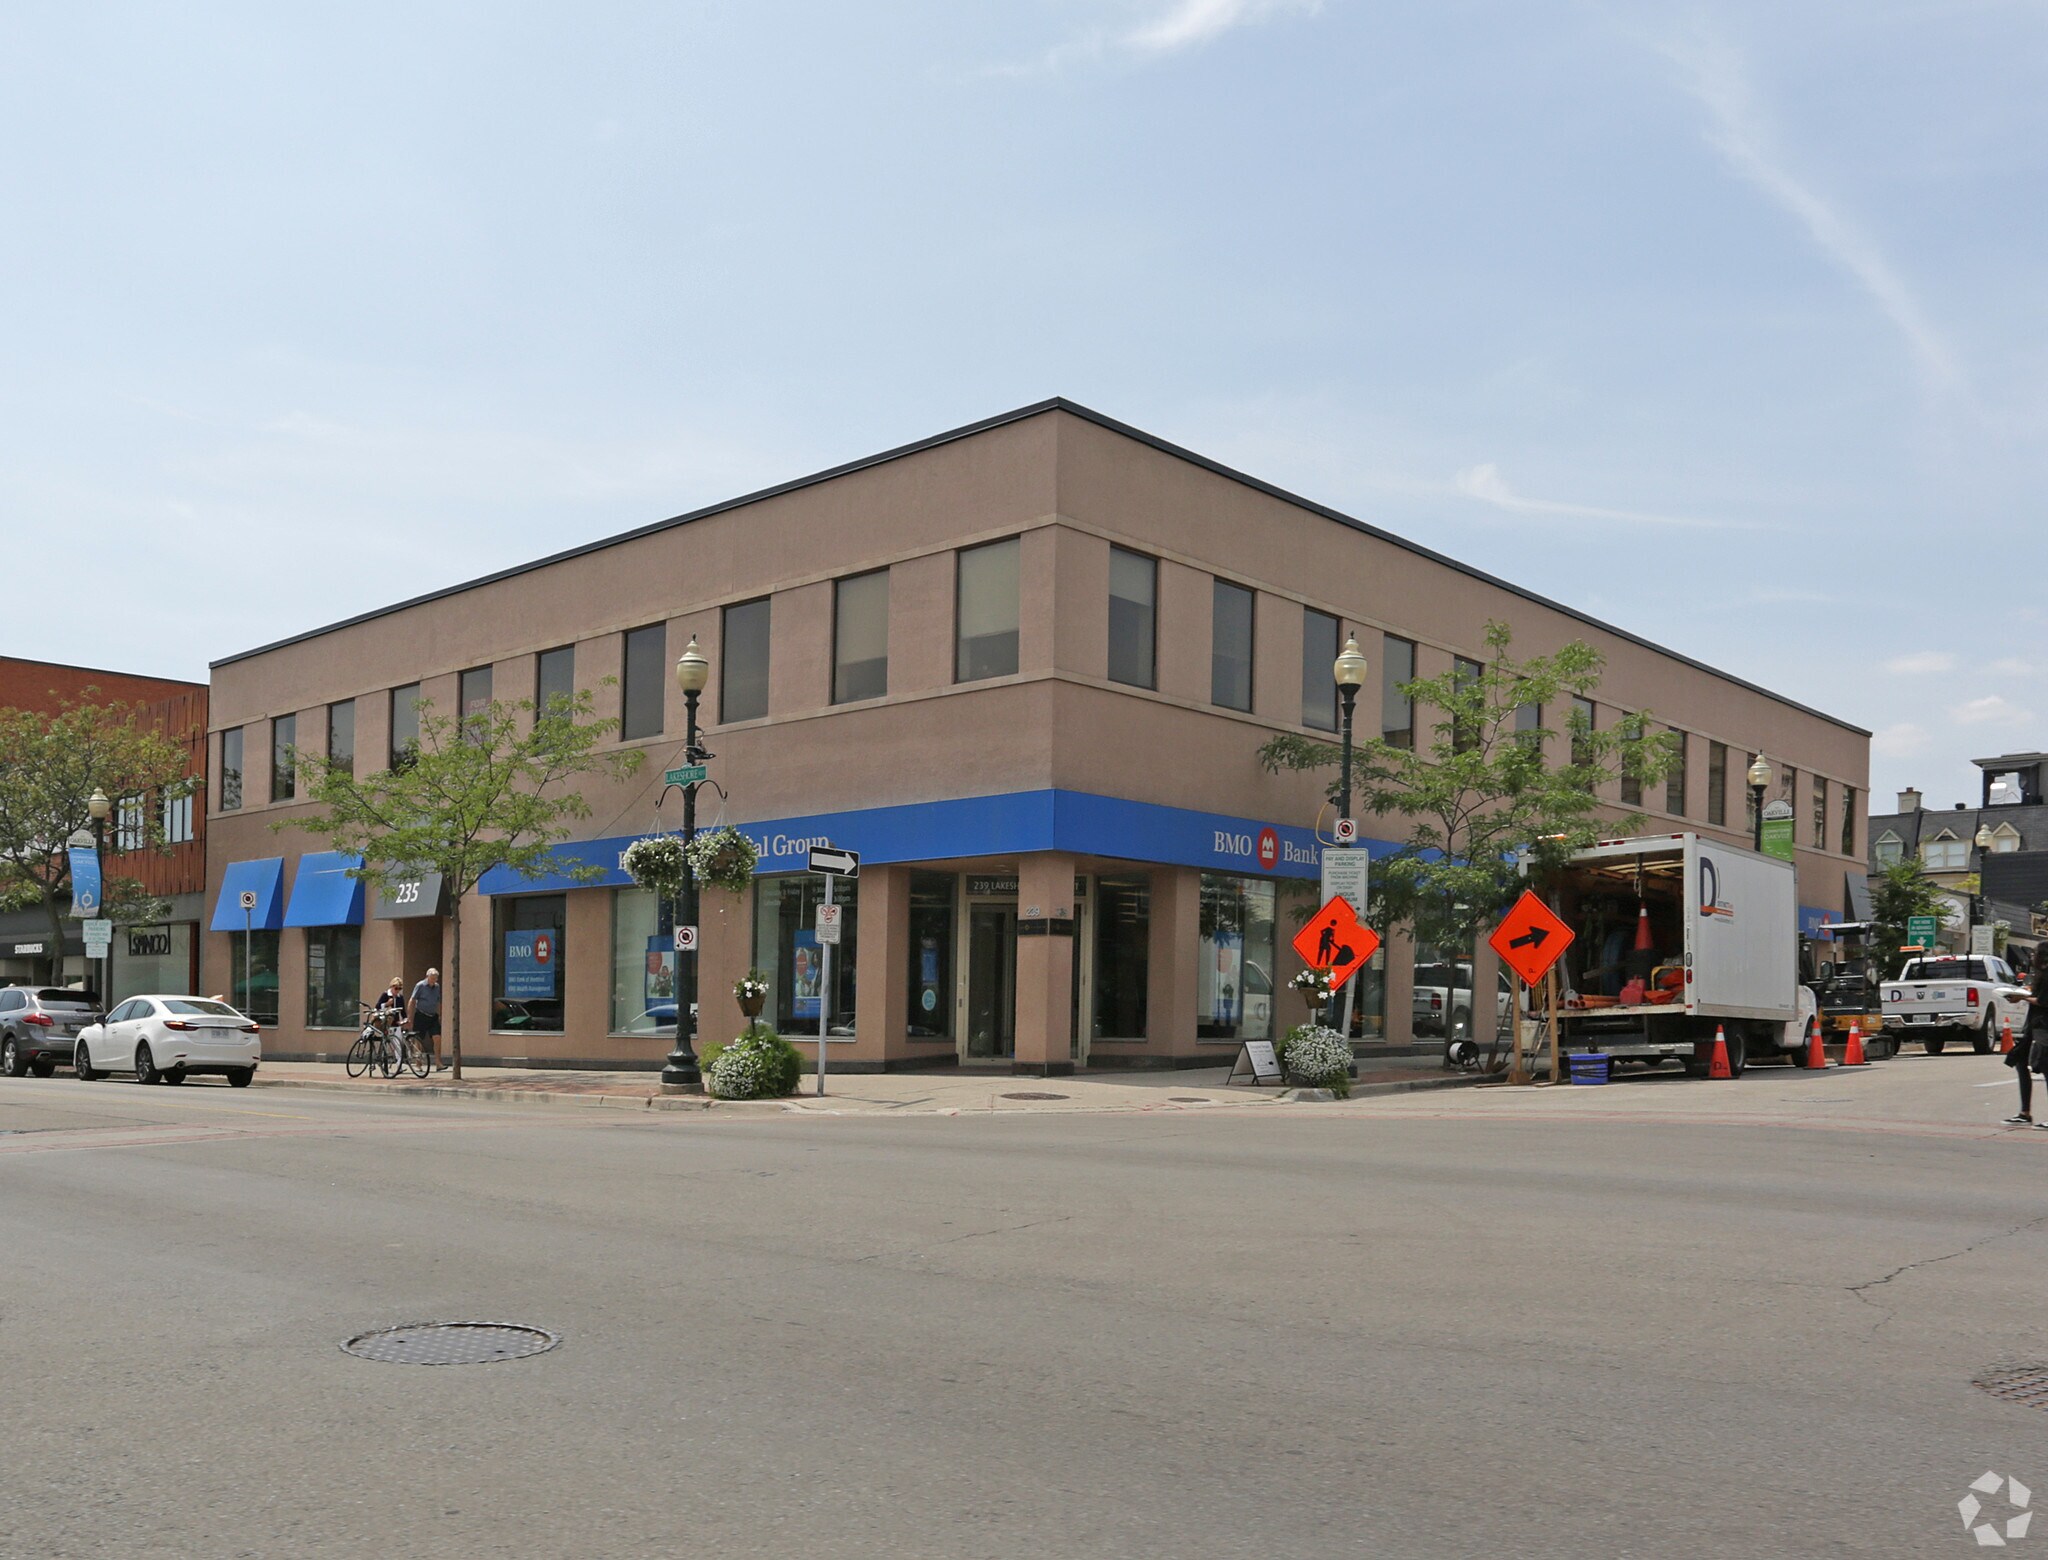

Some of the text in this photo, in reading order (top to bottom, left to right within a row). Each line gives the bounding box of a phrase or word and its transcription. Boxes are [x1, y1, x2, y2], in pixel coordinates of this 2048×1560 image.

[665, 769, 698, 782] LAKESHORE
[1764, 808, 1790, 816] OAKVILLE
[1214, 831, 1318, 865] BMO Bank
[974, 881, 1019, 890] 239 LAKESH
[395, 882, 420, 903] 235
[509, 945, 532, 958] BMO
